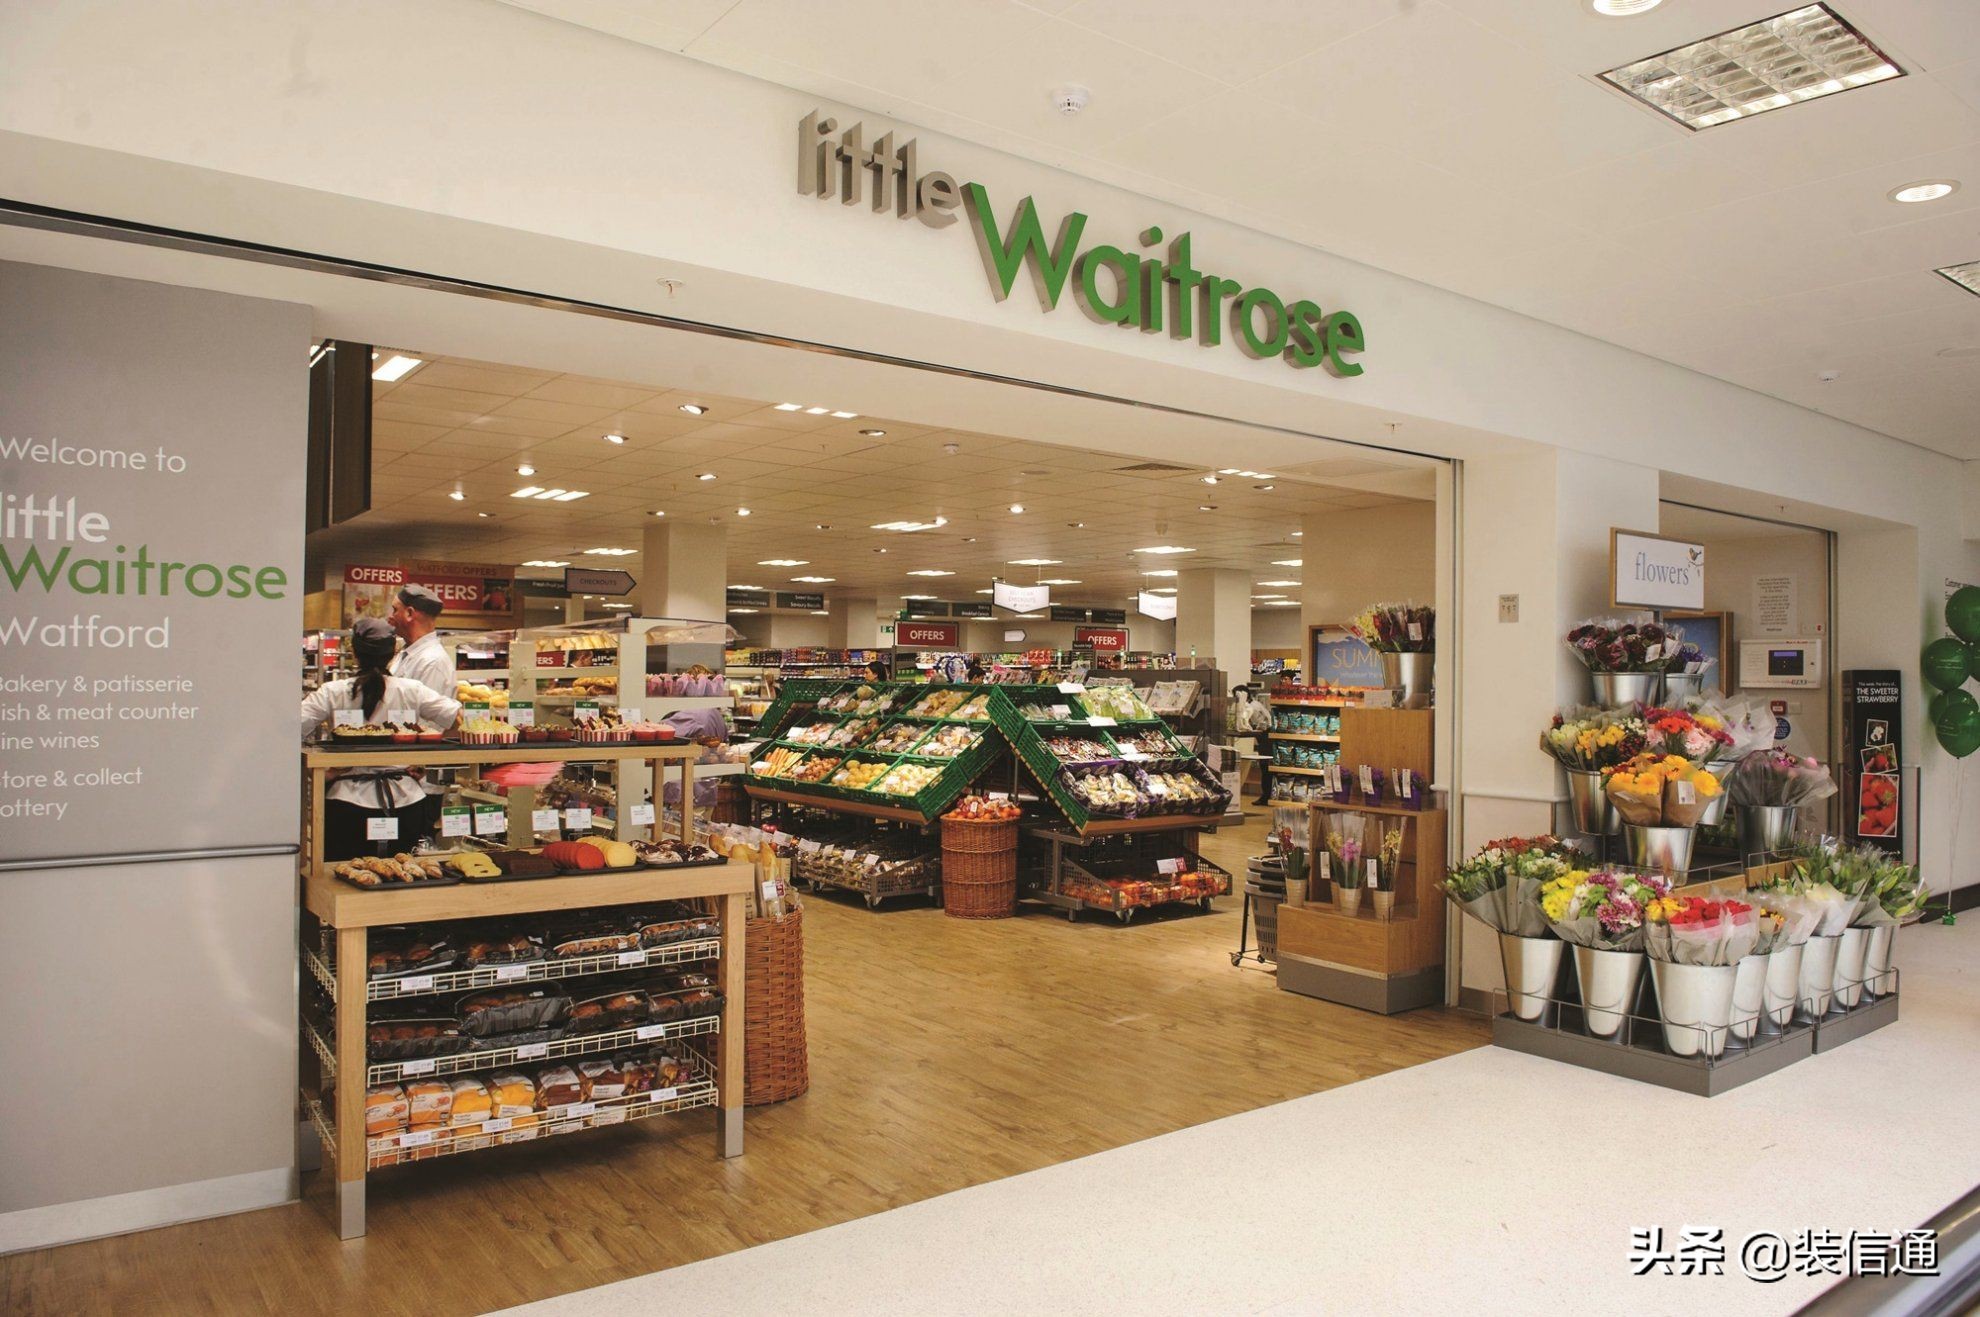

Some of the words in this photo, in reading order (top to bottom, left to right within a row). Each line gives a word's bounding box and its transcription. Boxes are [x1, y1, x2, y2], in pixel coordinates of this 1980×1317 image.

[797, 107, 961, 229] little
[959, 181, 1365, 379] Waitrose
[0, 436, 146, 471] Welcome
[155, 446, 187, 474] to
[0, 543, 288, 600] Waitrose
[351, 567, 403, 583] OFFERS
[1635, 551, 1689, 586] flowers
[0, 614, 170, 648] Watford
[909, 629, 945, 641] OFFERS
[1087, 635, 1118, 646] OFFERS
[72, 675, 88, 693] &
[93, 674, 194, 698] patisserie
[1856, 687, 1869, 696] THE
[1870, 687, 1899, 696] SWEETER
[1856, 695, 1899, 704] STRAWBERRY
[36, 703, 51, 721] &
[57, 702, 114, 721] meat
[118, 701, 200, 720] counter
[39, 730, 100, 749] wines
[53, 769, 68, 788] &
[73, 766, 144, 786] collect
